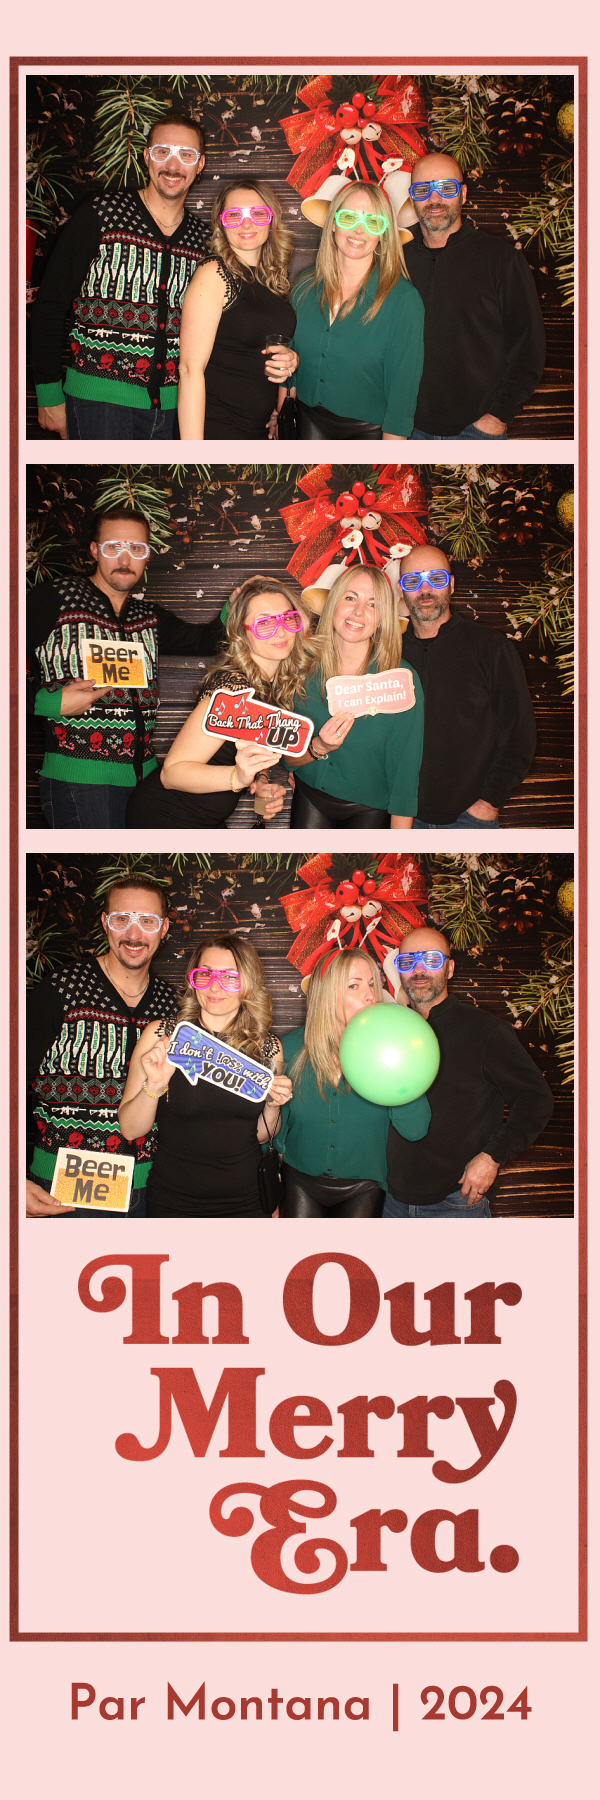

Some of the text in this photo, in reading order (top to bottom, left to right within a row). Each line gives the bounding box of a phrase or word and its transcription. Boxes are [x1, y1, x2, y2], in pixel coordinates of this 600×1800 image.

[89, 643, 138, 663] Beer
[102, 663, 130, 683] Me
[334, 679, 404, 696] Dear Santa,
[338, 690, 406, 708] I can Explain!
[208, 710, 301, 732] Back That Thang
[266, 727, 300, 750] UP
[168, 1041, 179, 1054] I
[179, 1041, 215, 1060] don't
[242, 1068, 272, 1090] with
[200, 1061, 246, 1092] YOU!
[64, 1153, 126, 1181] Beer
[72, 1177, 109, 1203] Me
